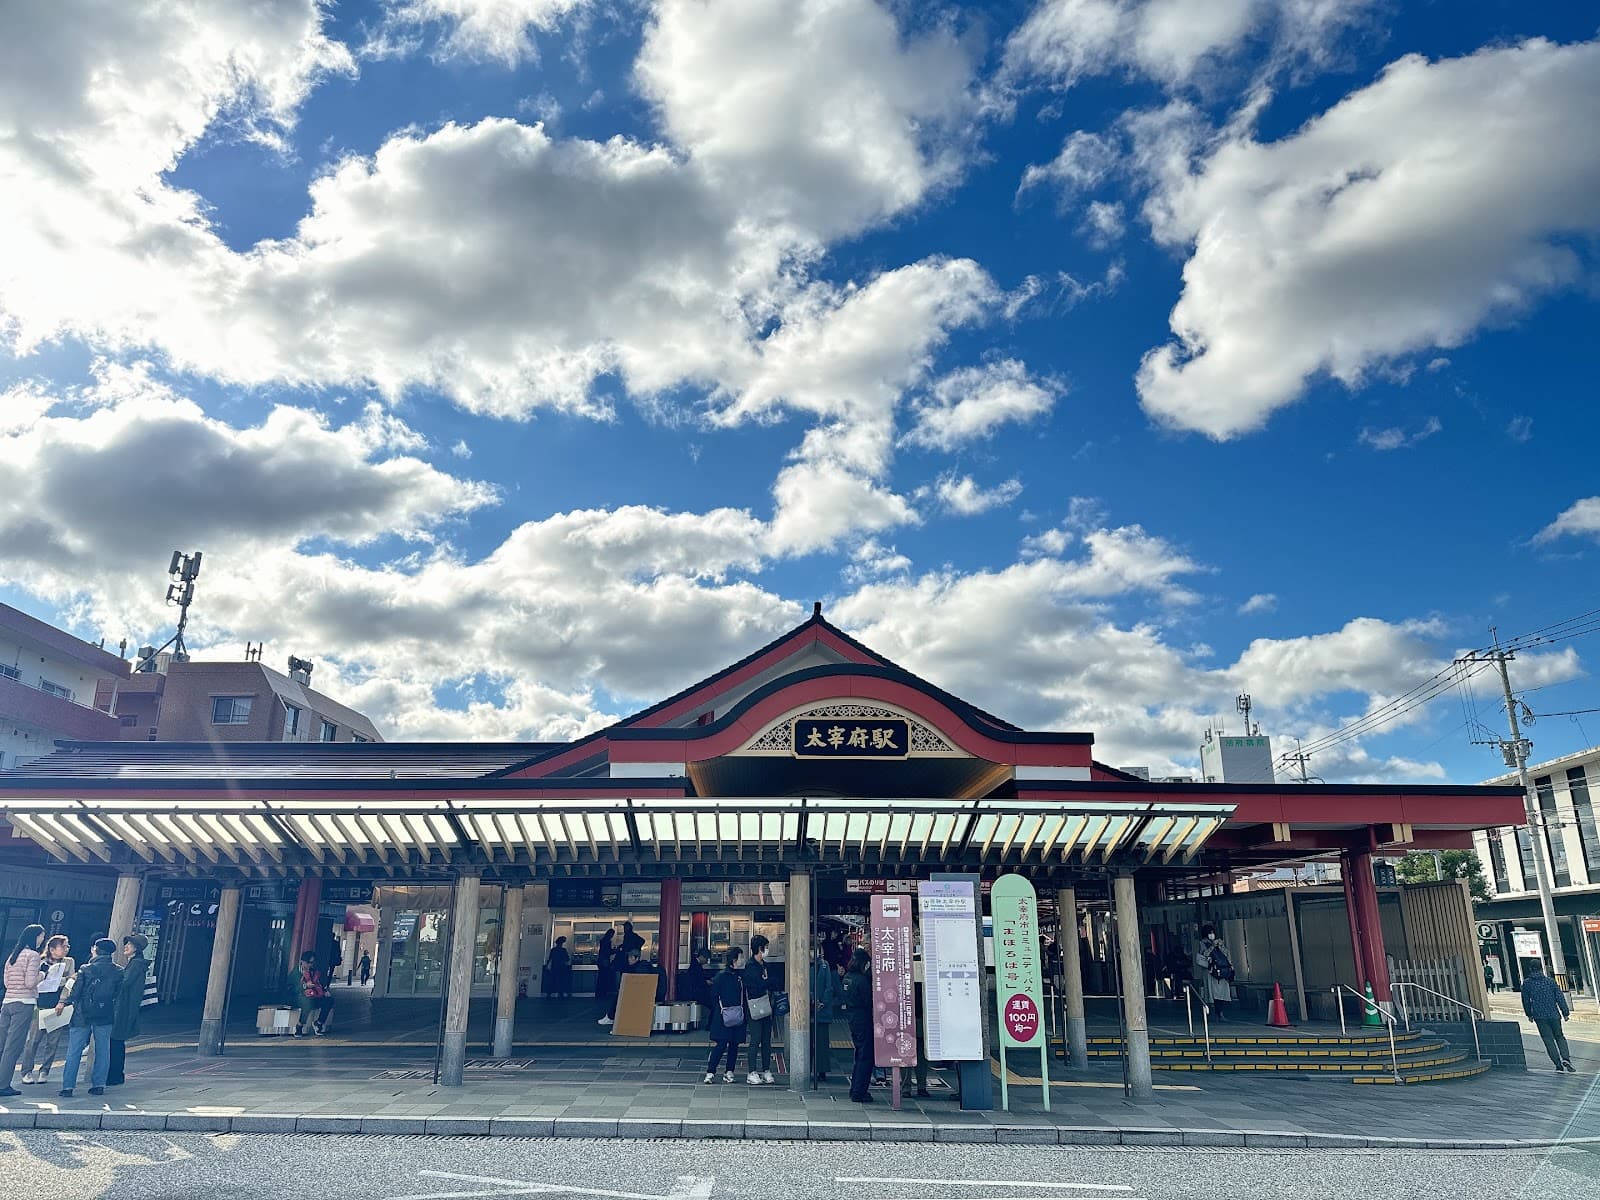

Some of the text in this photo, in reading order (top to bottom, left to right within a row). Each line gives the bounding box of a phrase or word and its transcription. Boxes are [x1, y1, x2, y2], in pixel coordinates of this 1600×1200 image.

[803, 725, 899, 751] 太宰府駅
[880, 926, 896, 972] 太宰府
[1018, 897, 1034, 993] 太宰府市コミュニティバス
[1012, 1001, 1030, 1010] 運賃
[1008, 1013, 1036, 1022] 100円
[1014, 1023, 1033, 1033] 均一
